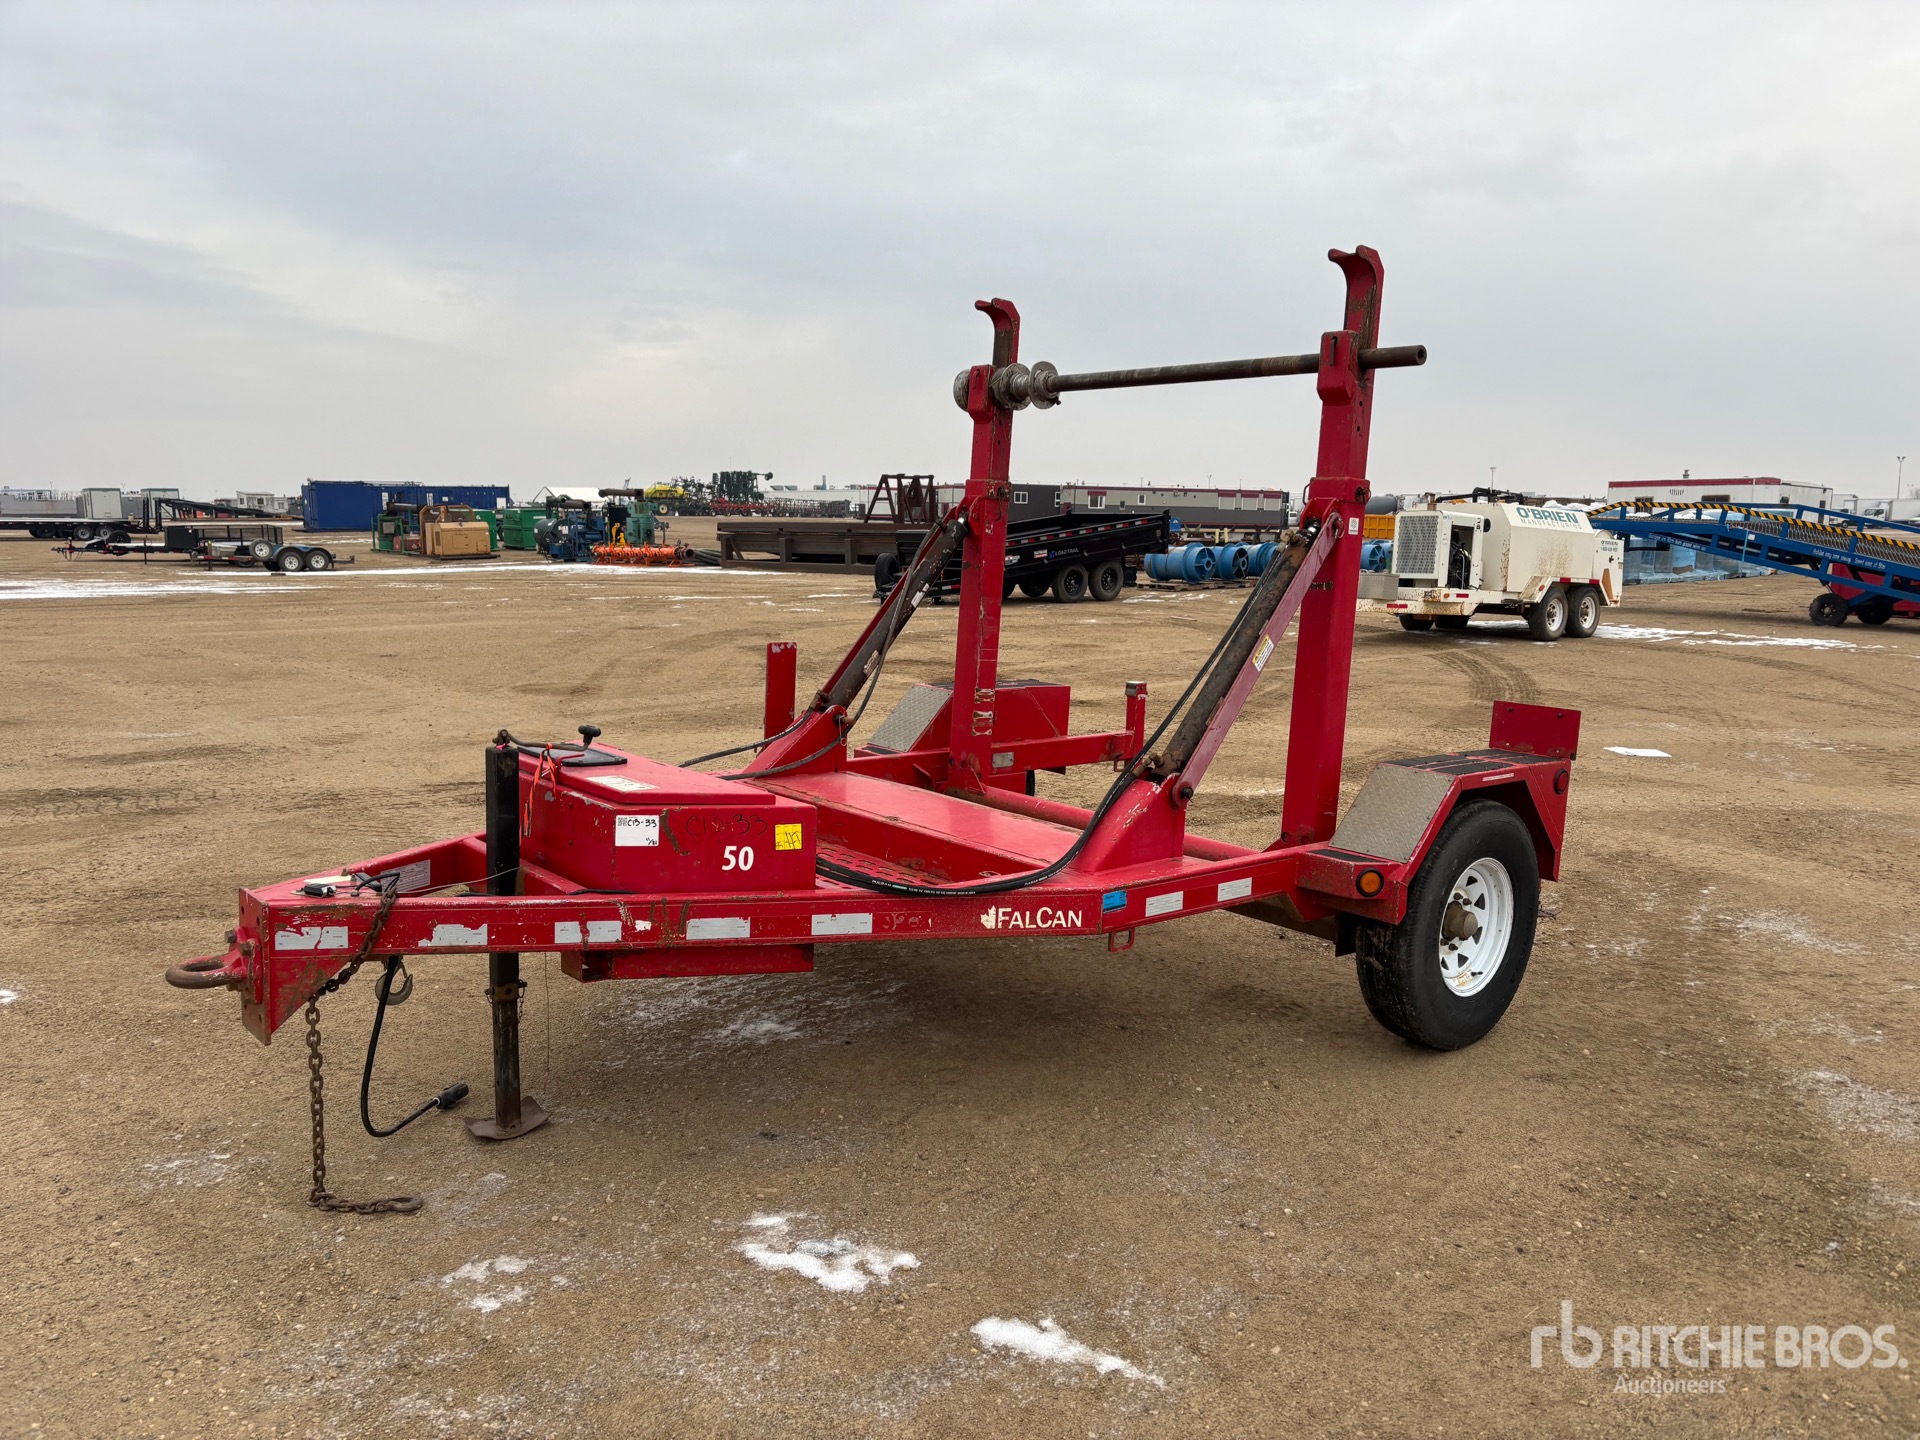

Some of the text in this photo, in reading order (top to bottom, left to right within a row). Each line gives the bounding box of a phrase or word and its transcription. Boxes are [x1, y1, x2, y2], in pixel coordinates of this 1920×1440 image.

[1516, 507, 1580, 524] O'BRIEN
[1520, 518, 1583, 530] MANUFACTURING
[721, 845, 755, 872] 50
